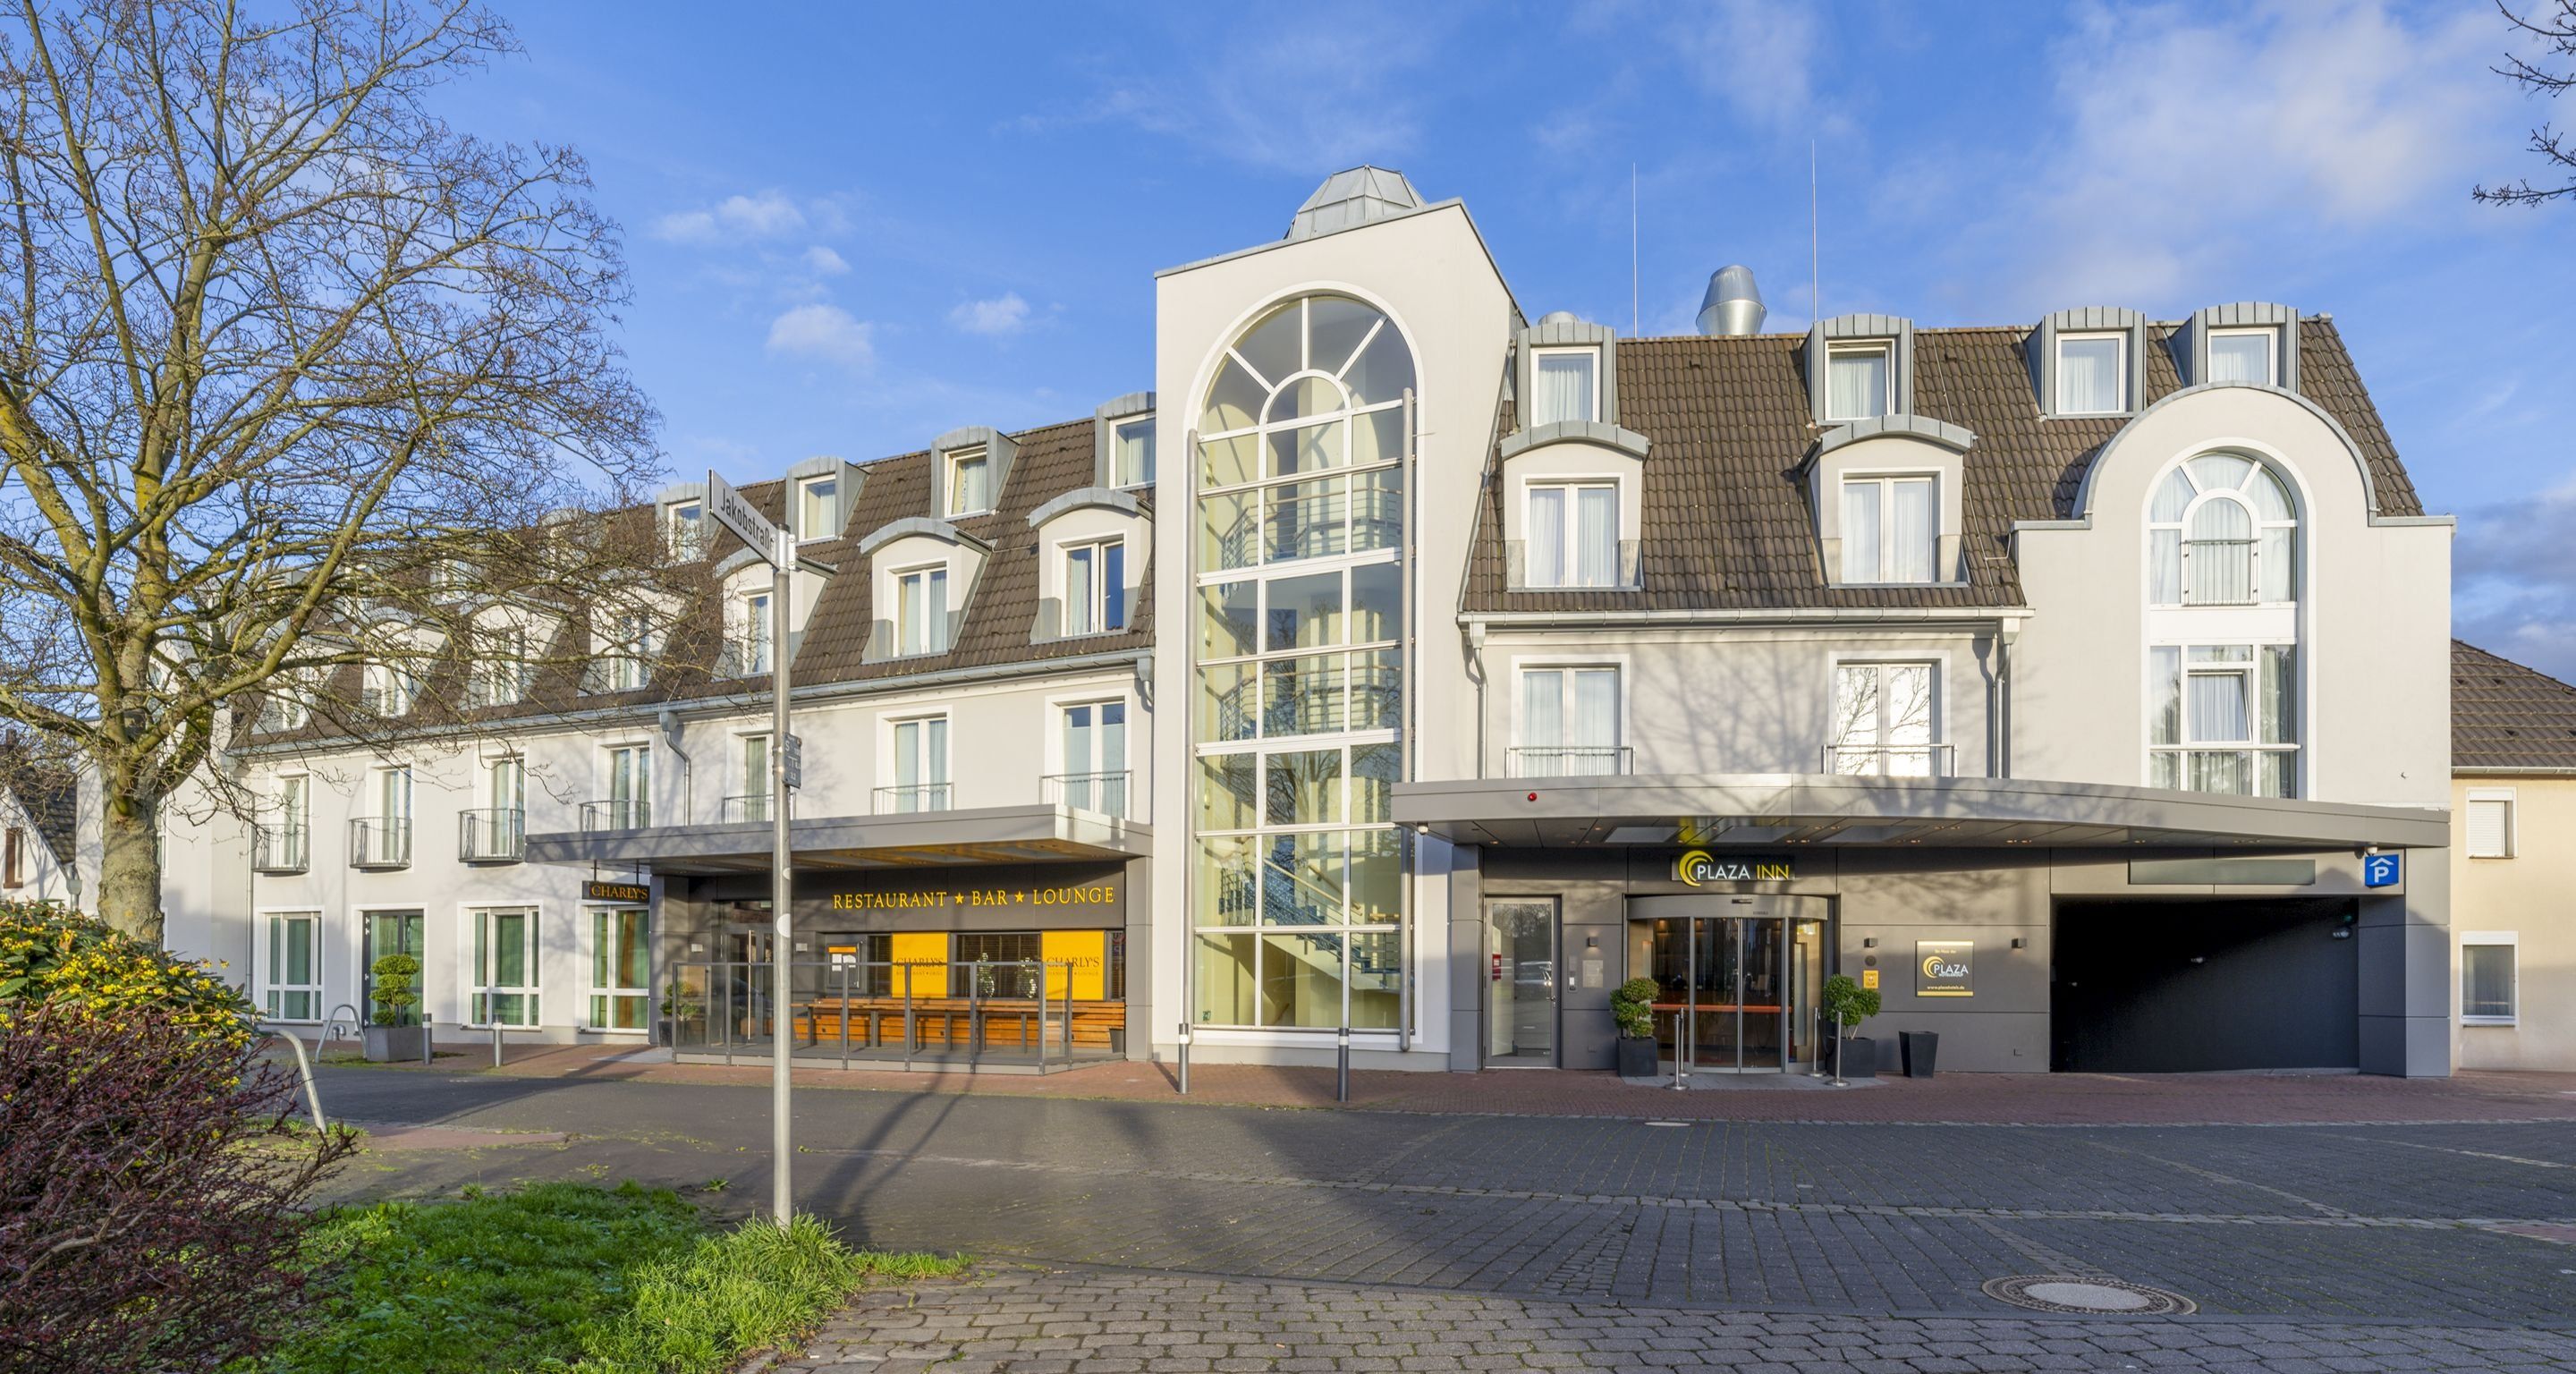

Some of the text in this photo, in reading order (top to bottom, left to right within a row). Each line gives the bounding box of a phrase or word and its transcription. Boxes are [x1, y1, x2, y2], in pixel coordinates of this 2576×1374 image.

[1697, 864, 1789, 880] PLAZA INN
[2374, 866, 2389, 883] P
[591, 885, 648, 900] CHARLY'S
[833, 886, 1114, 910] RESTAURANT BAR LOUNGE
[1934, 964, 1969, 973] PLAZA
